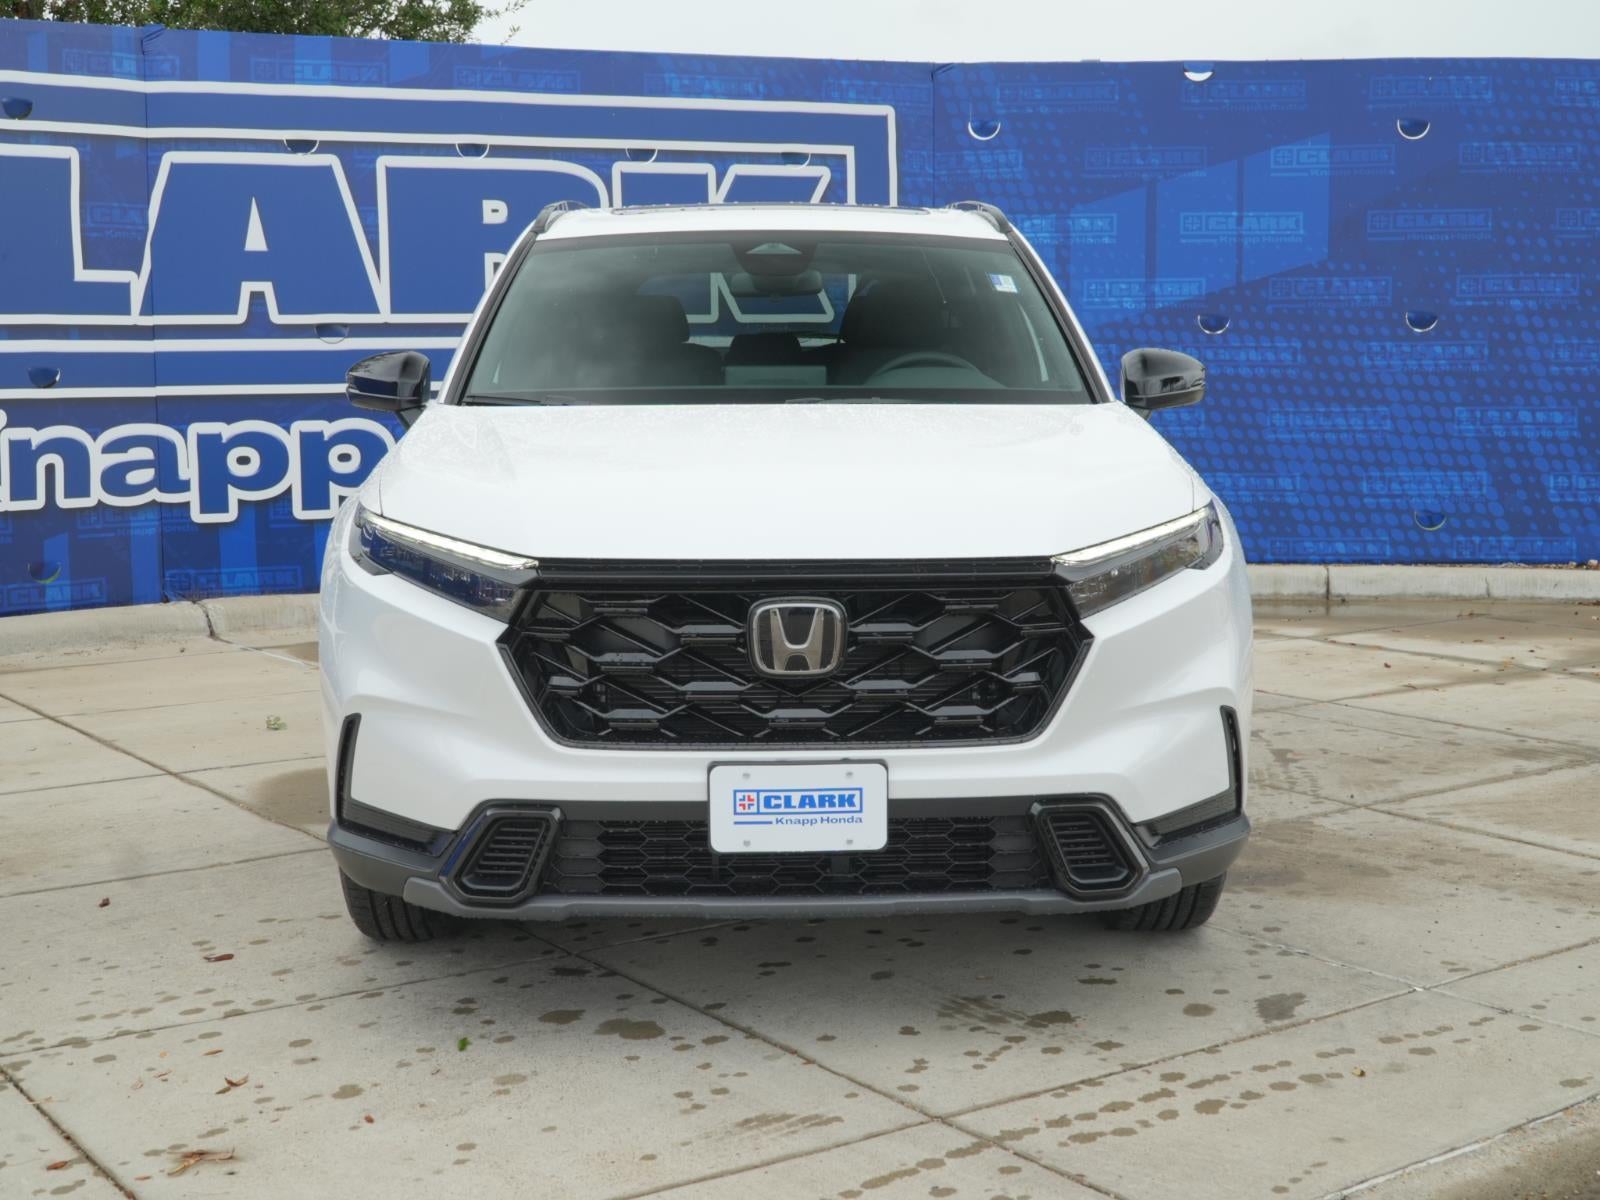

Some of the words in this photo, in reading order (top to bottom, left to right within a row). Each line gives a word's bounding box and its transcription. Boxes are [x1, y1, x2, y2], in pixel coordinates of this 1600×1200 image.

[1208, 216, 1297, 230] CLARK
[1396, 214, 1486, 227] CLARK
[764, 794, 857, 810] CLARK
[775, 816, 818, 827] Knapp
[820, 815, 863, 825] Honda
